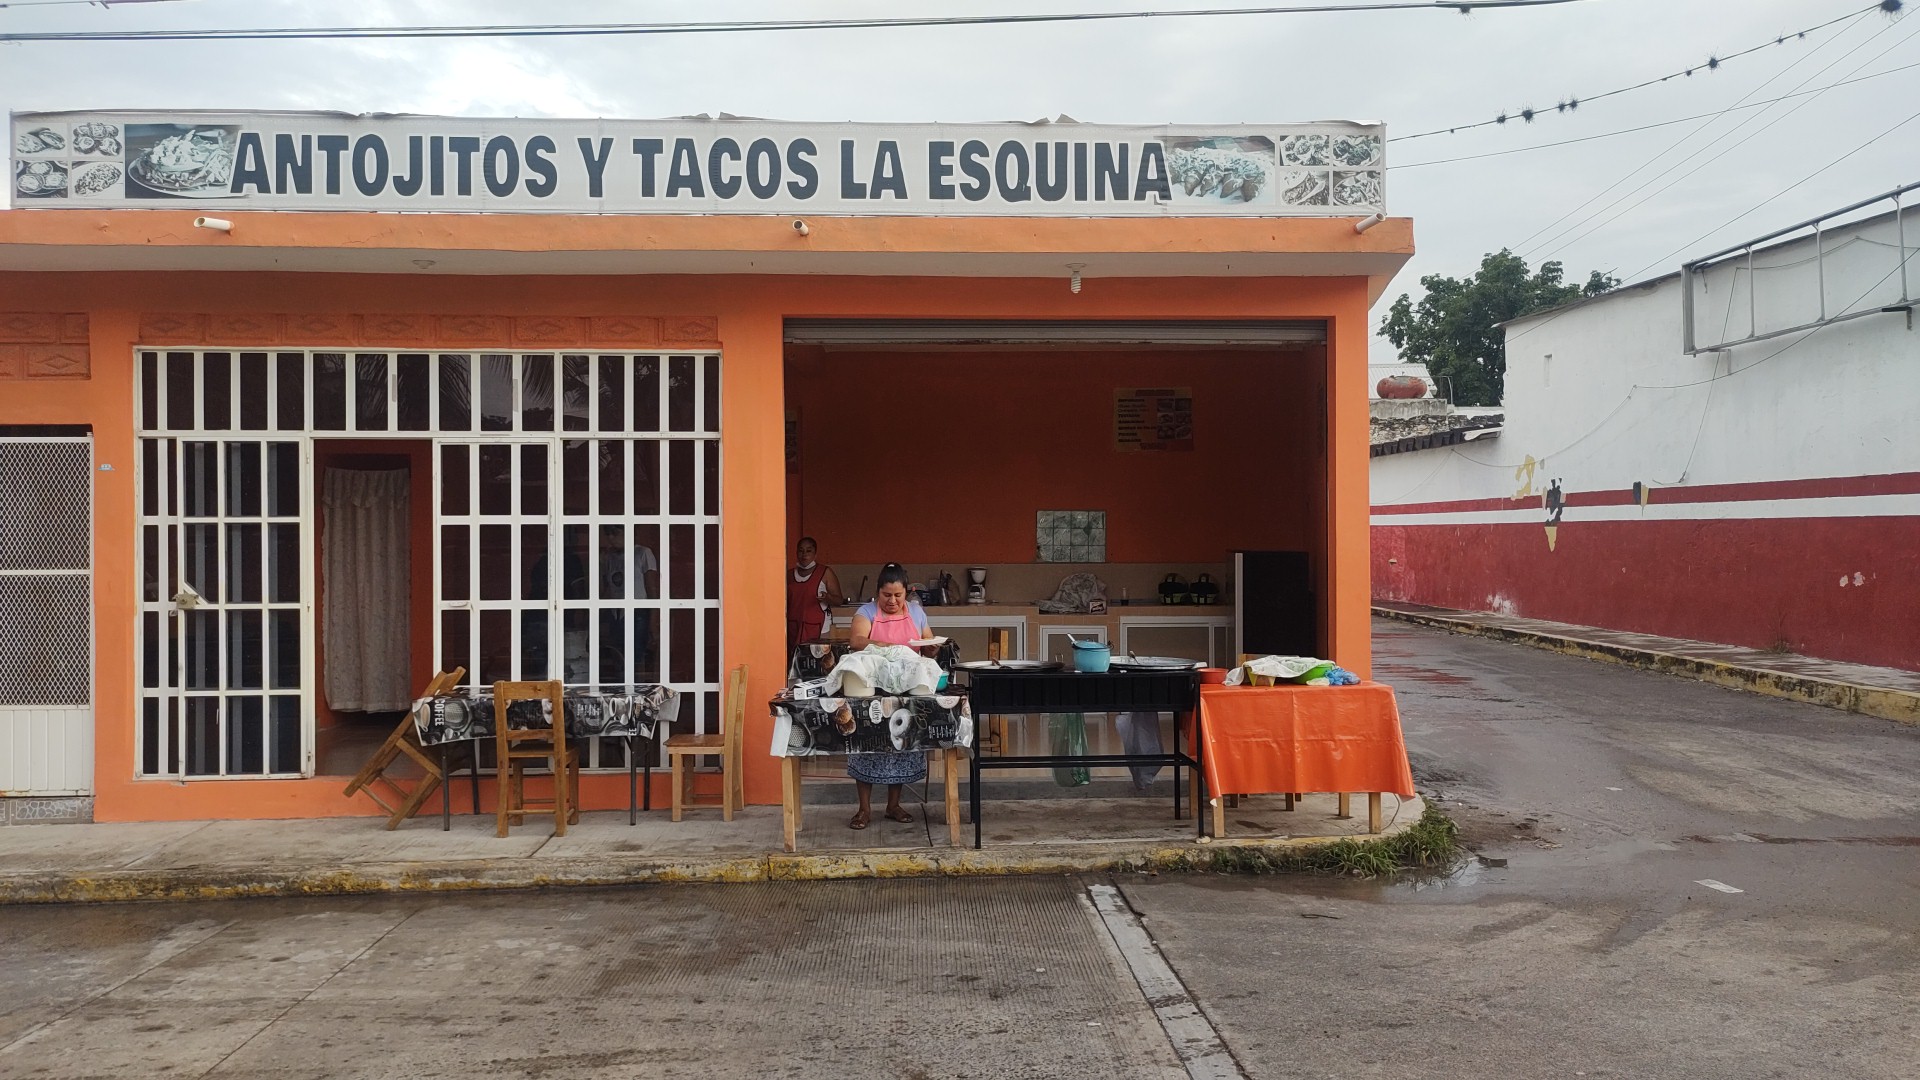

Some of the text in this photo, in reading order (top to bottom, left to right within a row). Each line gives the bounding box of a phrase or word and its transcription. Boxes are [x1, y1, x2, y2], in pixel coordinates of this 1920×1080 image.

[230, 132, 1173, 203] ANTOJITOS Y TACOS LA ESQUINA
[433, 698, 446, 727] COFFEE
